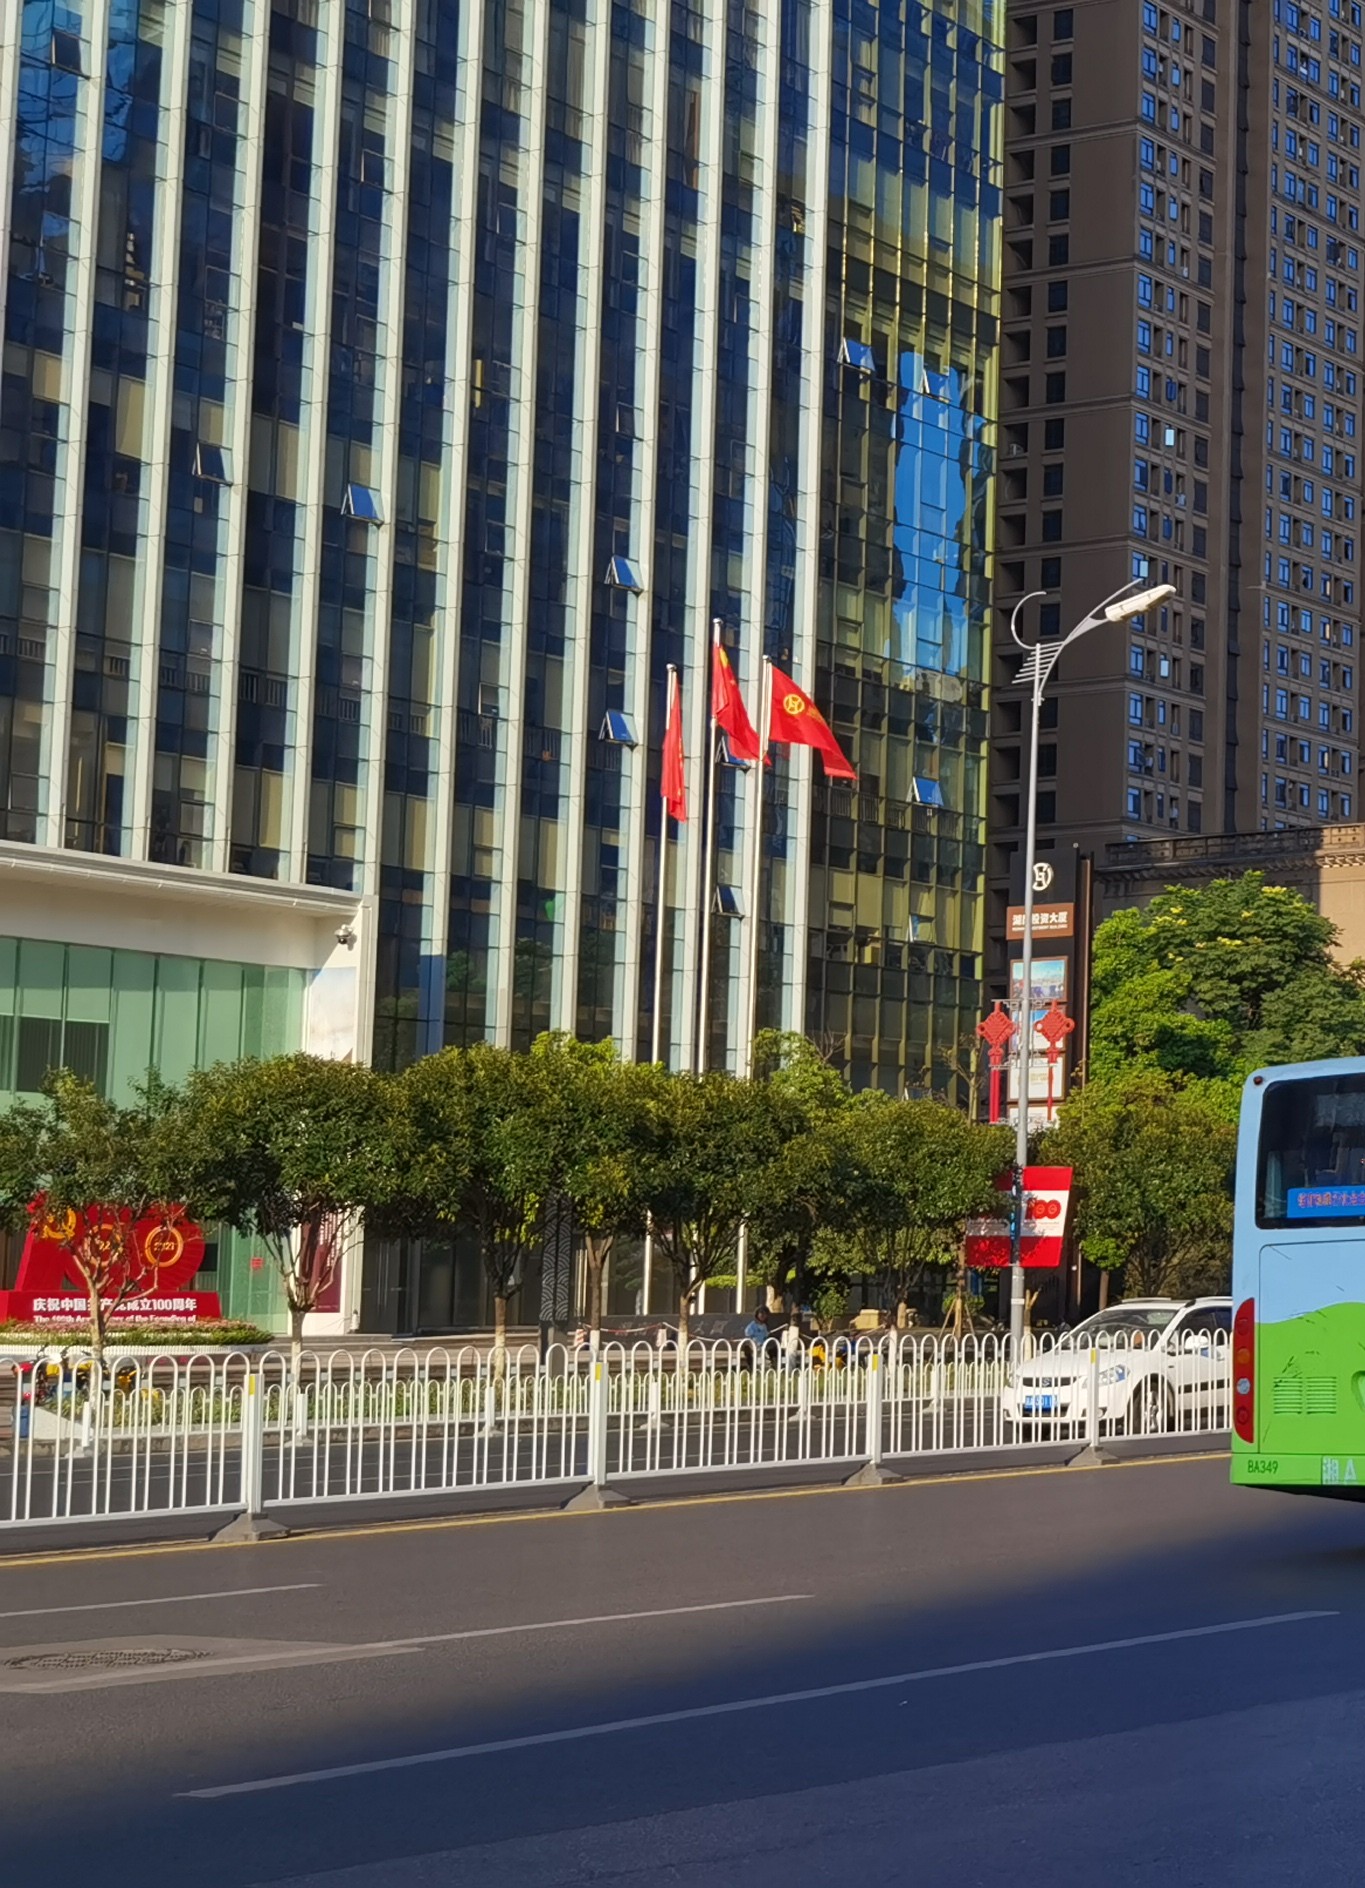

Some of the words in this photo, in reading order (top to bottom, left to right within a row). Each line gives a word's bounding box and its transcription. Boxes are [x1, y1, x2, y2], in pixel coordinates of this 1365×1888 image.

[33, 1298, 197, 1311] 庆祝中国产成立100周年
[1247, 1460, 1279, 1475] BA349
